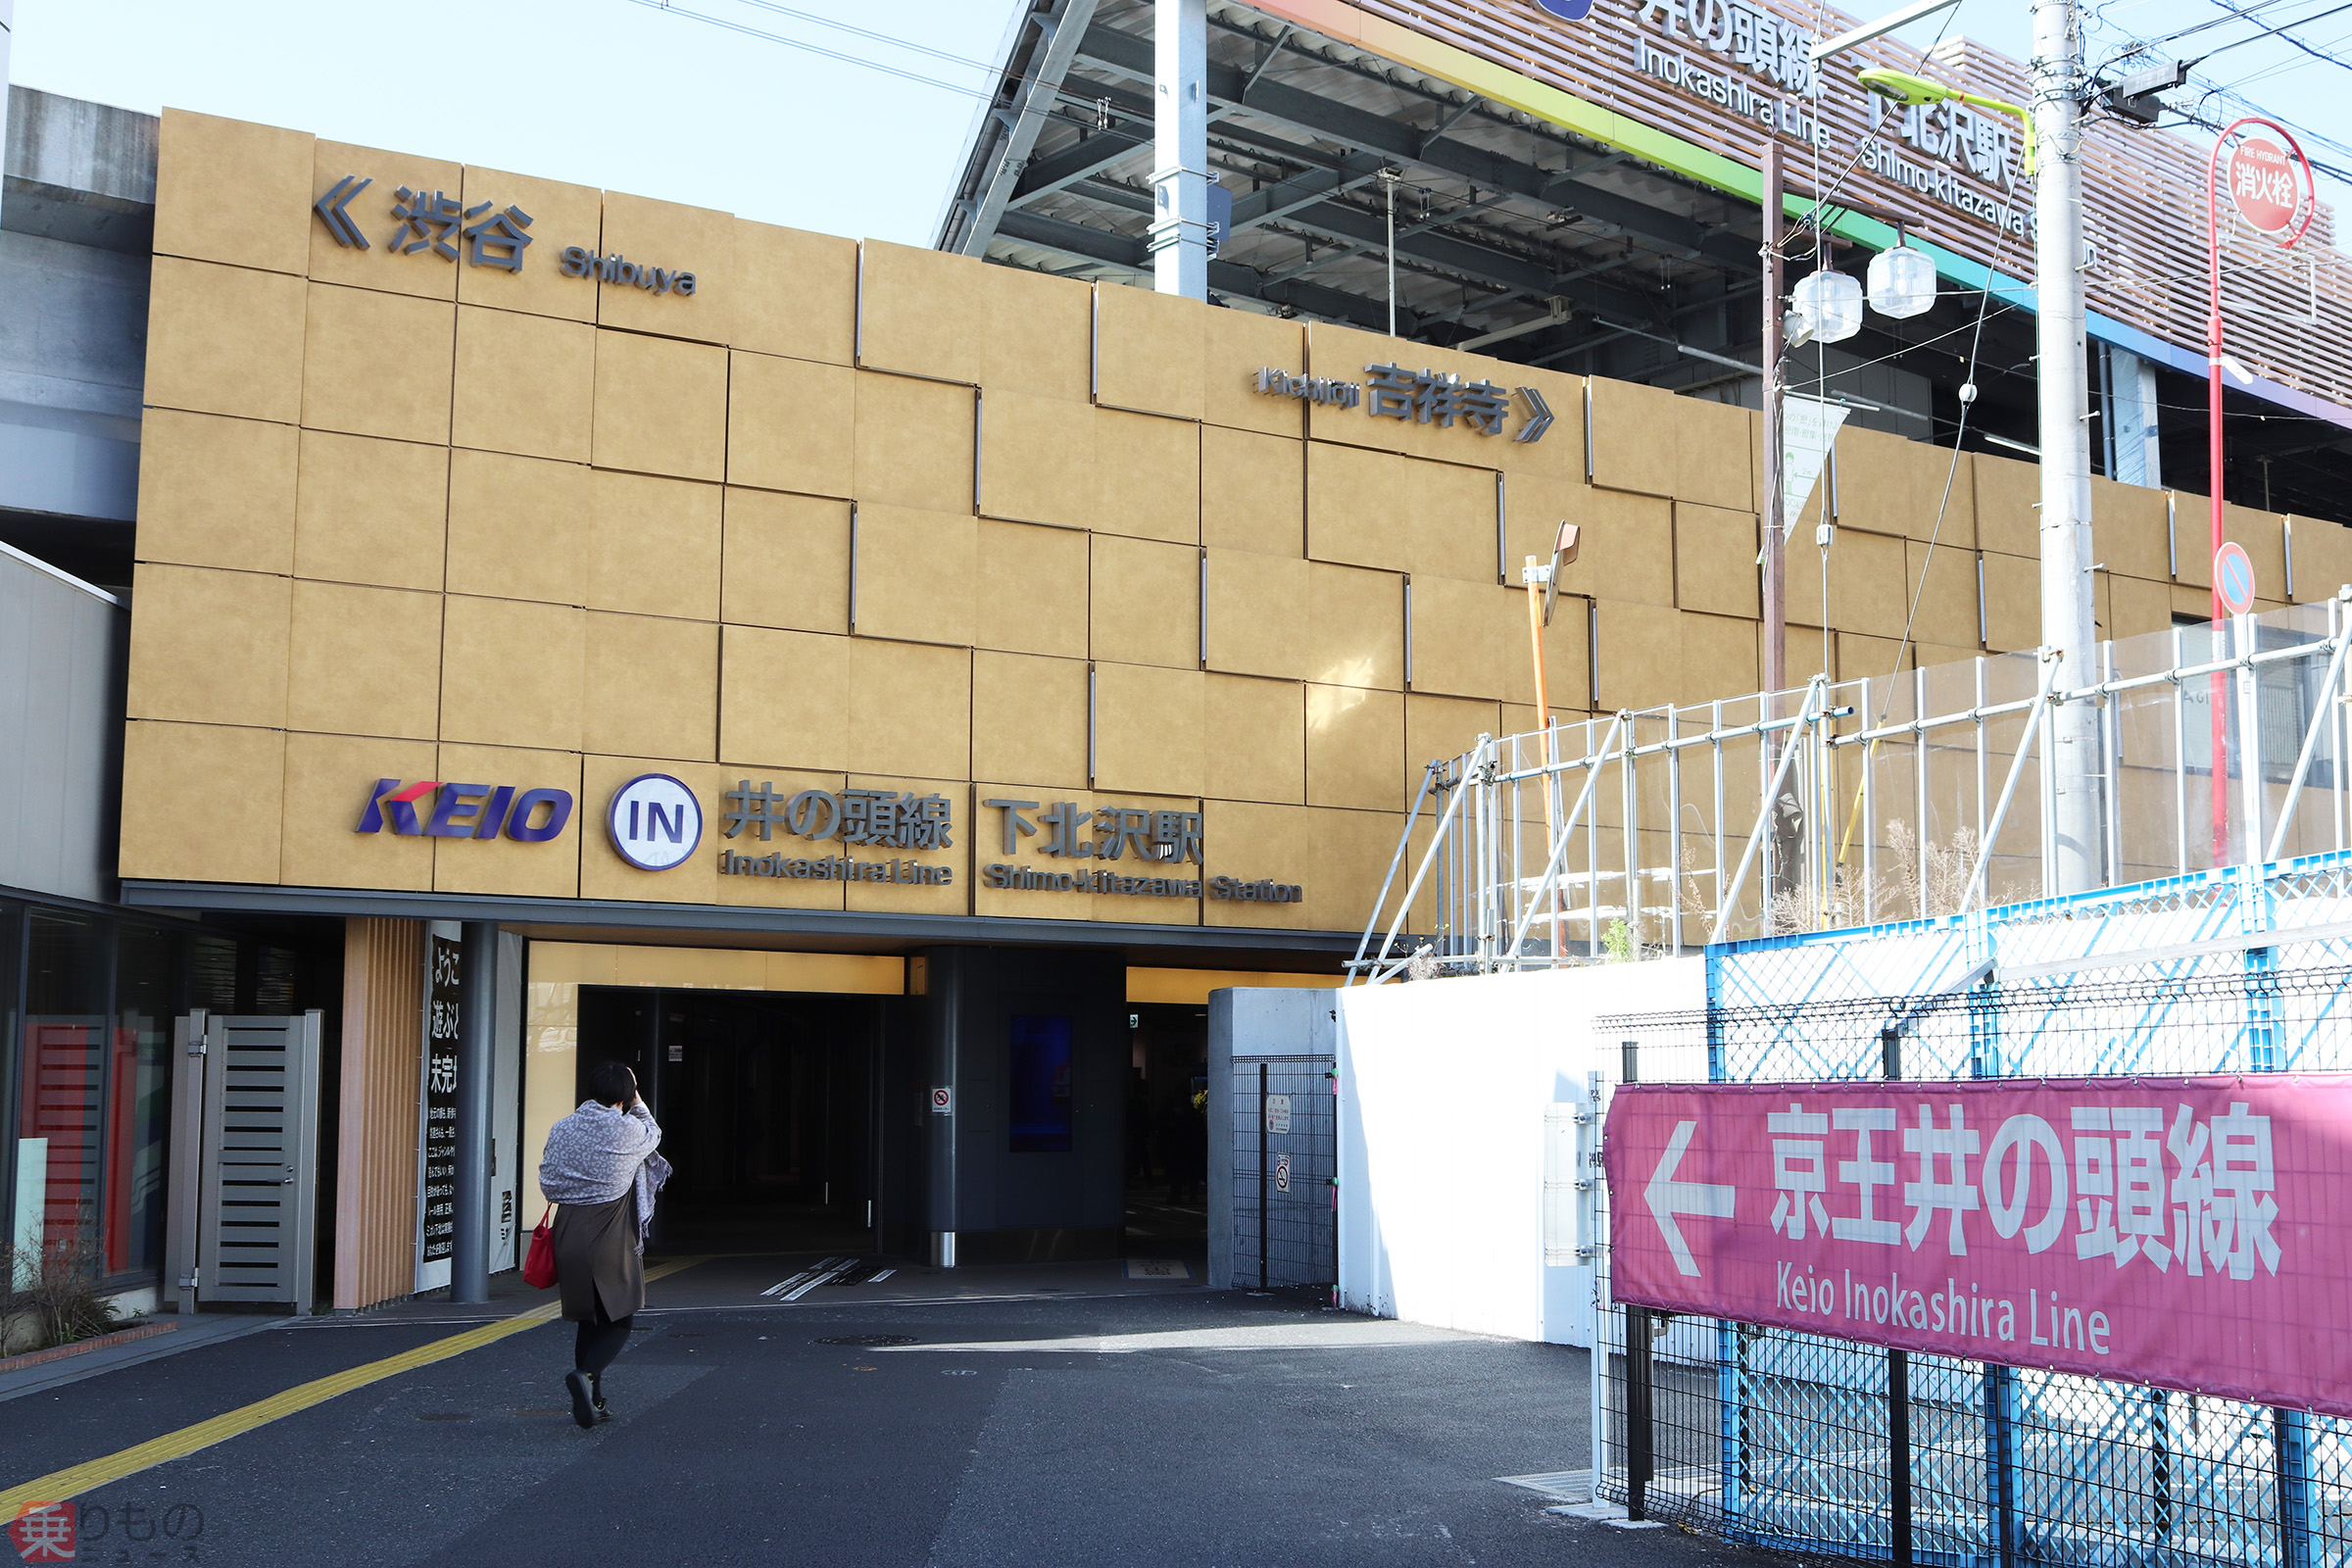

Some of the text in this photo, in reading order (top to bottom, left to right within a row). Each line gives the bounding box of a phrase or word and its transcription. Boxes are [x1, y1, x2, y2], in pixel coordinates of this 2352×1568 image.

[1635, 37, 2025, 236] Inokashira Line Shimo-kitazawa
[2240, 145, 2286, 166] FIRE HYDRANT
[2235, 161, 2293, 209] 消火栓
[389, 184, 534, 274] 渋谷
[560, 245, 697, 297] Shibuya
[1256, 366, 1360, 411] Kichijoji
[1364, 361, 1509, 436] 吉祥寺
[354, 778, 573, 842] KEIO
[628, 800, 684, 844] IN
[723, 779, 1203, 865] 井の頭線 下北沢駅
[720, 849, 1303, 904] Inokashira Line Shimo-kitazawa Station
[1767, 1101, 2282, 1281] 京王井の頭線
[1777, 1260, 2110, 1355] Keio Inokashira Line
